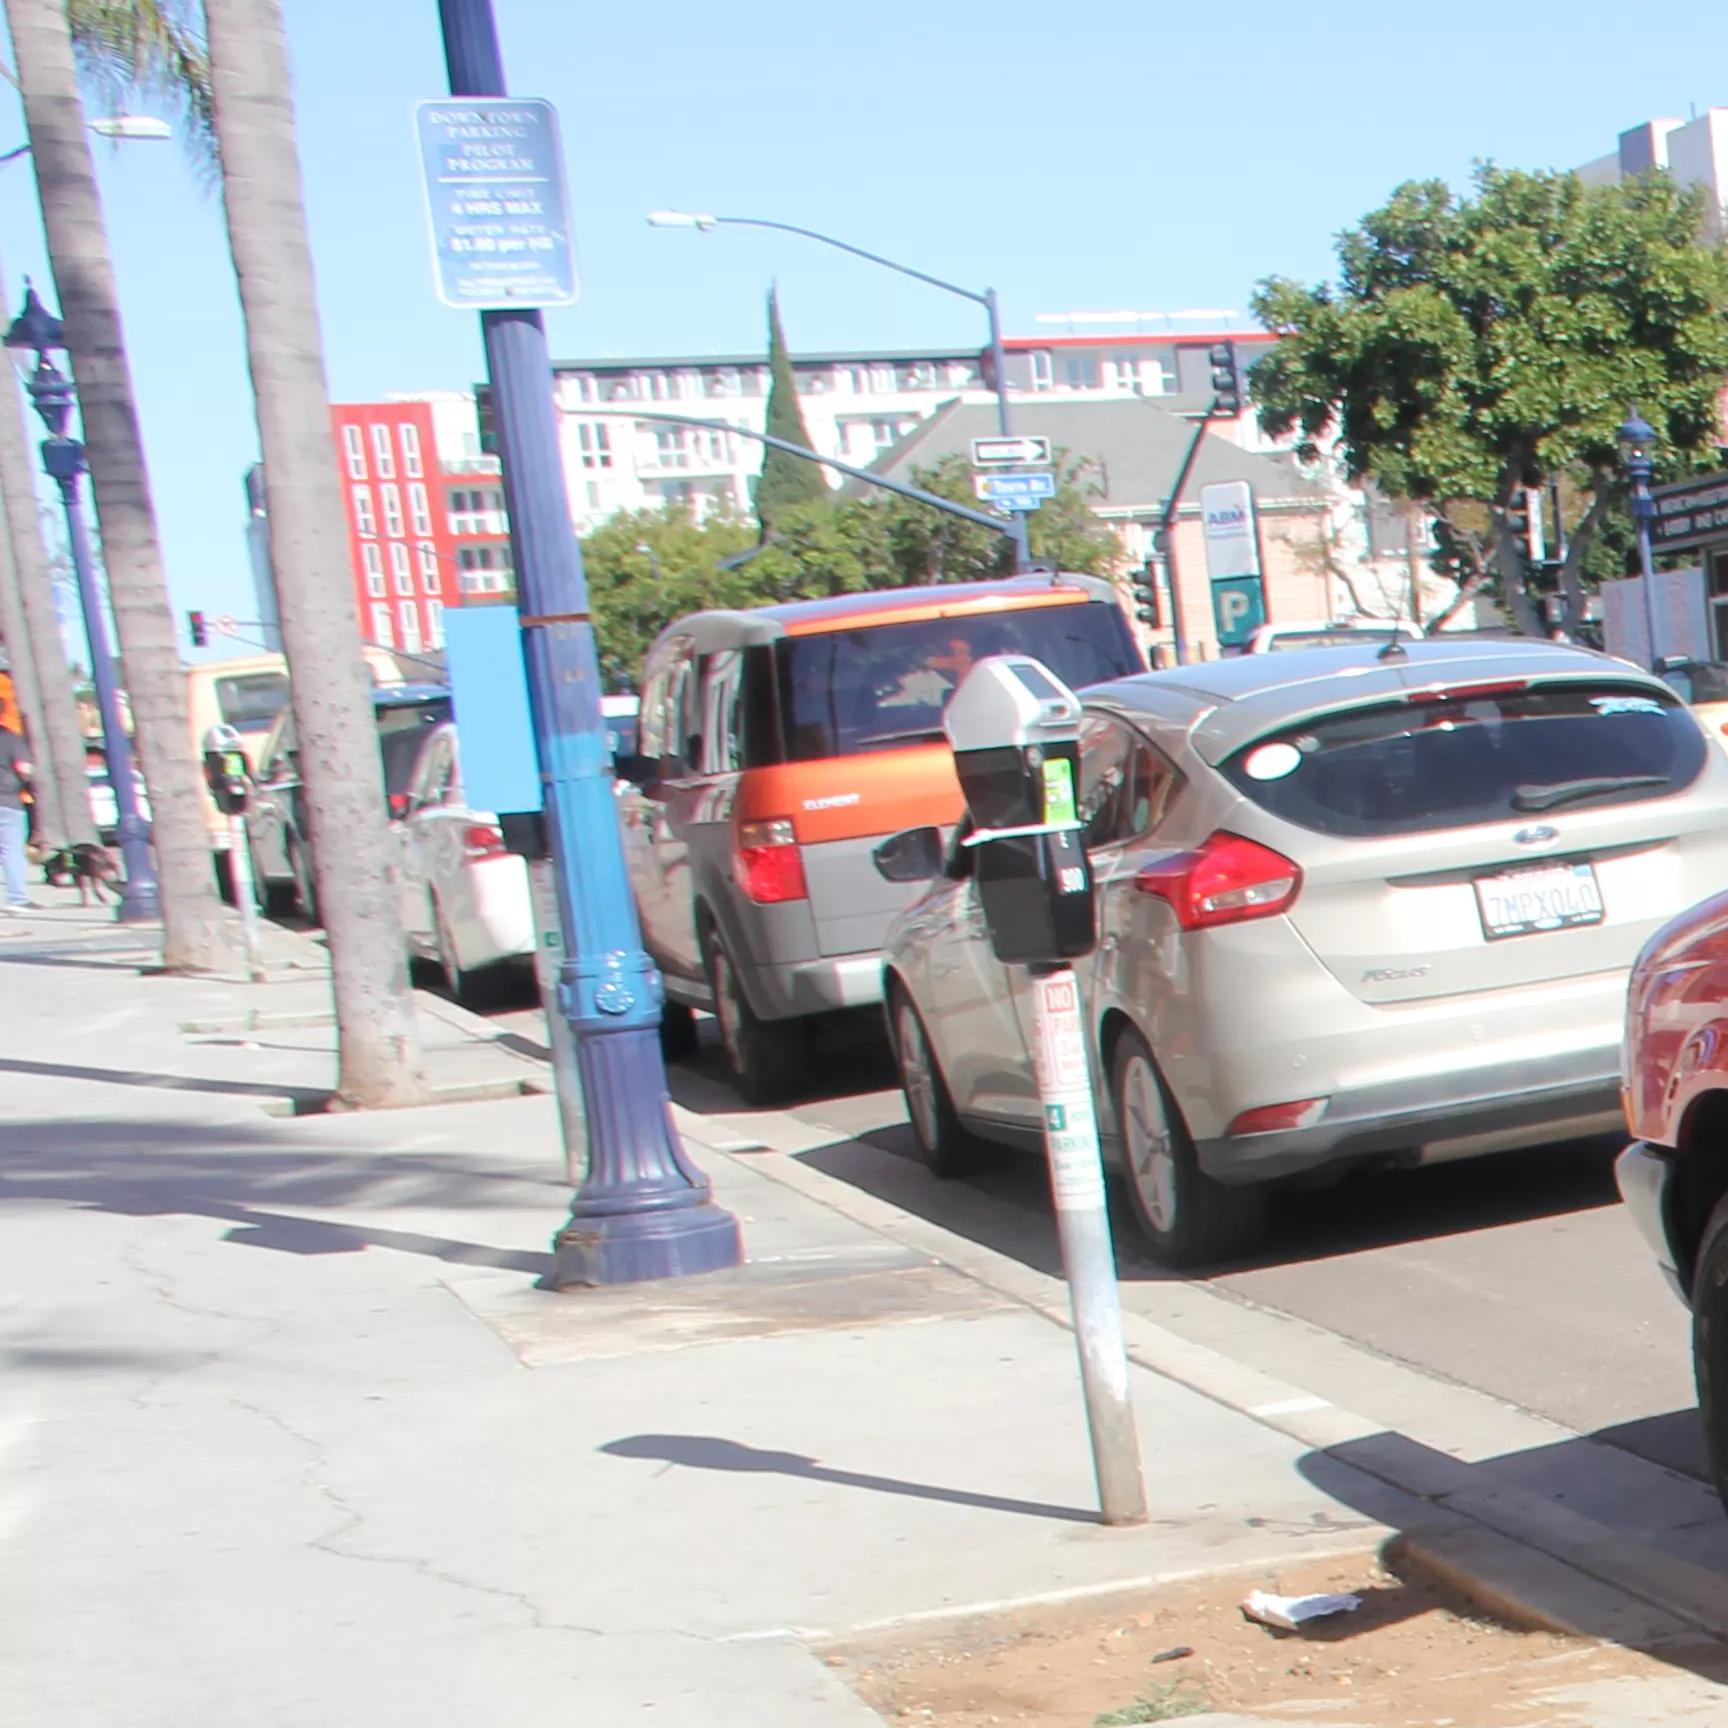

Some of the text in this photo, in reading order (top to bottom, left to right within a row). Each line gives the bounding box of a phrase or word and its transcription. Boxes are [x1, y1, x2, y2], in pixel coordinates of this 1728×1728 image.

[430, 111, 539, 124] DOWNTOWN
[446, 126, 527, 138] PARKING
[462, 144, 515, 157] PILOT
[446, 158, 535, 172] PROGRAM
[504, 201, 545, 215] MAX
[1047, 986, 1072, 1009] NO
